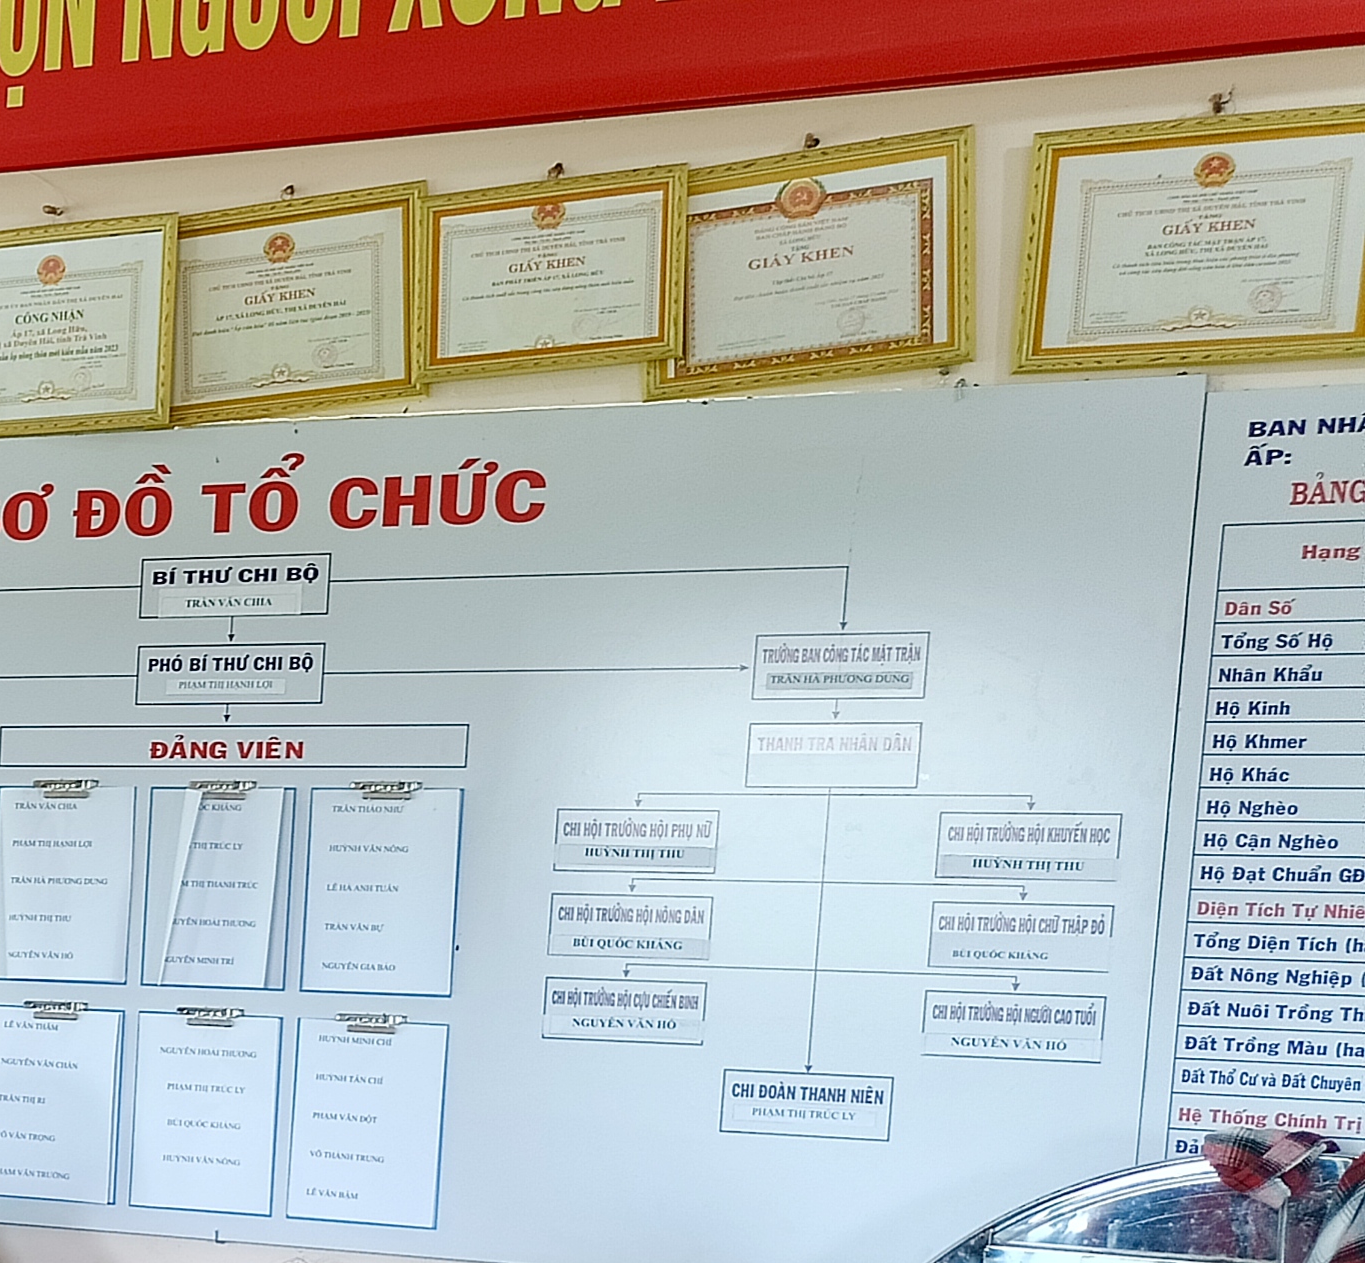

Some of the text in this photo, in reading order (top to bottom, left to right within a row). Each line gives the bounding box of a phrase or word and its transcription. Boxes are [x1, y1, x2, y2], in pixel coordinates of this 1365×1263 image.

[1243, 442, 1292, 467] ẤP:
[72, 463, 173, 538] ĐỒ
[201, 452, 306, 534] TỔ
[329, 457, 547, 530] CHỨC
[1289, 471, 1365, 506] BẢNG
[1221, 631, 1333, 652] Tổng Số Hộ
[1215, 700, 1291, 719] Hộ Kinh
[149, 734, 304, 760] ĐẢNG VIÊN
[1212, 734, 1308, 752] Hộ Khmer
[561, 816, 713, 841] CHI HỘI TRƯỞNG HỘI PHỤ NỮ
[1196, 901, 1239, 920] Diện
[1244, 902, 1286, 918] Tích
[1291, 903, 1320, 922] Tự
[1193, 931, 1241, 952] Tổng
[1247, 935, 1290, 952] Diện
[1296, 936, 1337, 952] Tích
[1190, 964, 1353, 989] Đất Nông Nghiệp
[1187, 1000, 1221, 1017] Đất
[1227, 1003, 1270, 1018] Nuôi
[1275, 1003, 1334, 1024] Trồng
[1184, 1034, 1218, 1052] Đất
[1223, 1036, 1281, 1057] Trồng
[1286, 1040, 1328, 1056] Màu
[731, 1080, 885, 1106] CHI ĐOÀN THANH NIÊN
[1181, 1067, 1362, 1094] Đất Thổ Cư và Đất Chuyên
[1178, 1107, 1362, 1134] Hệ Thống Chính Trị
